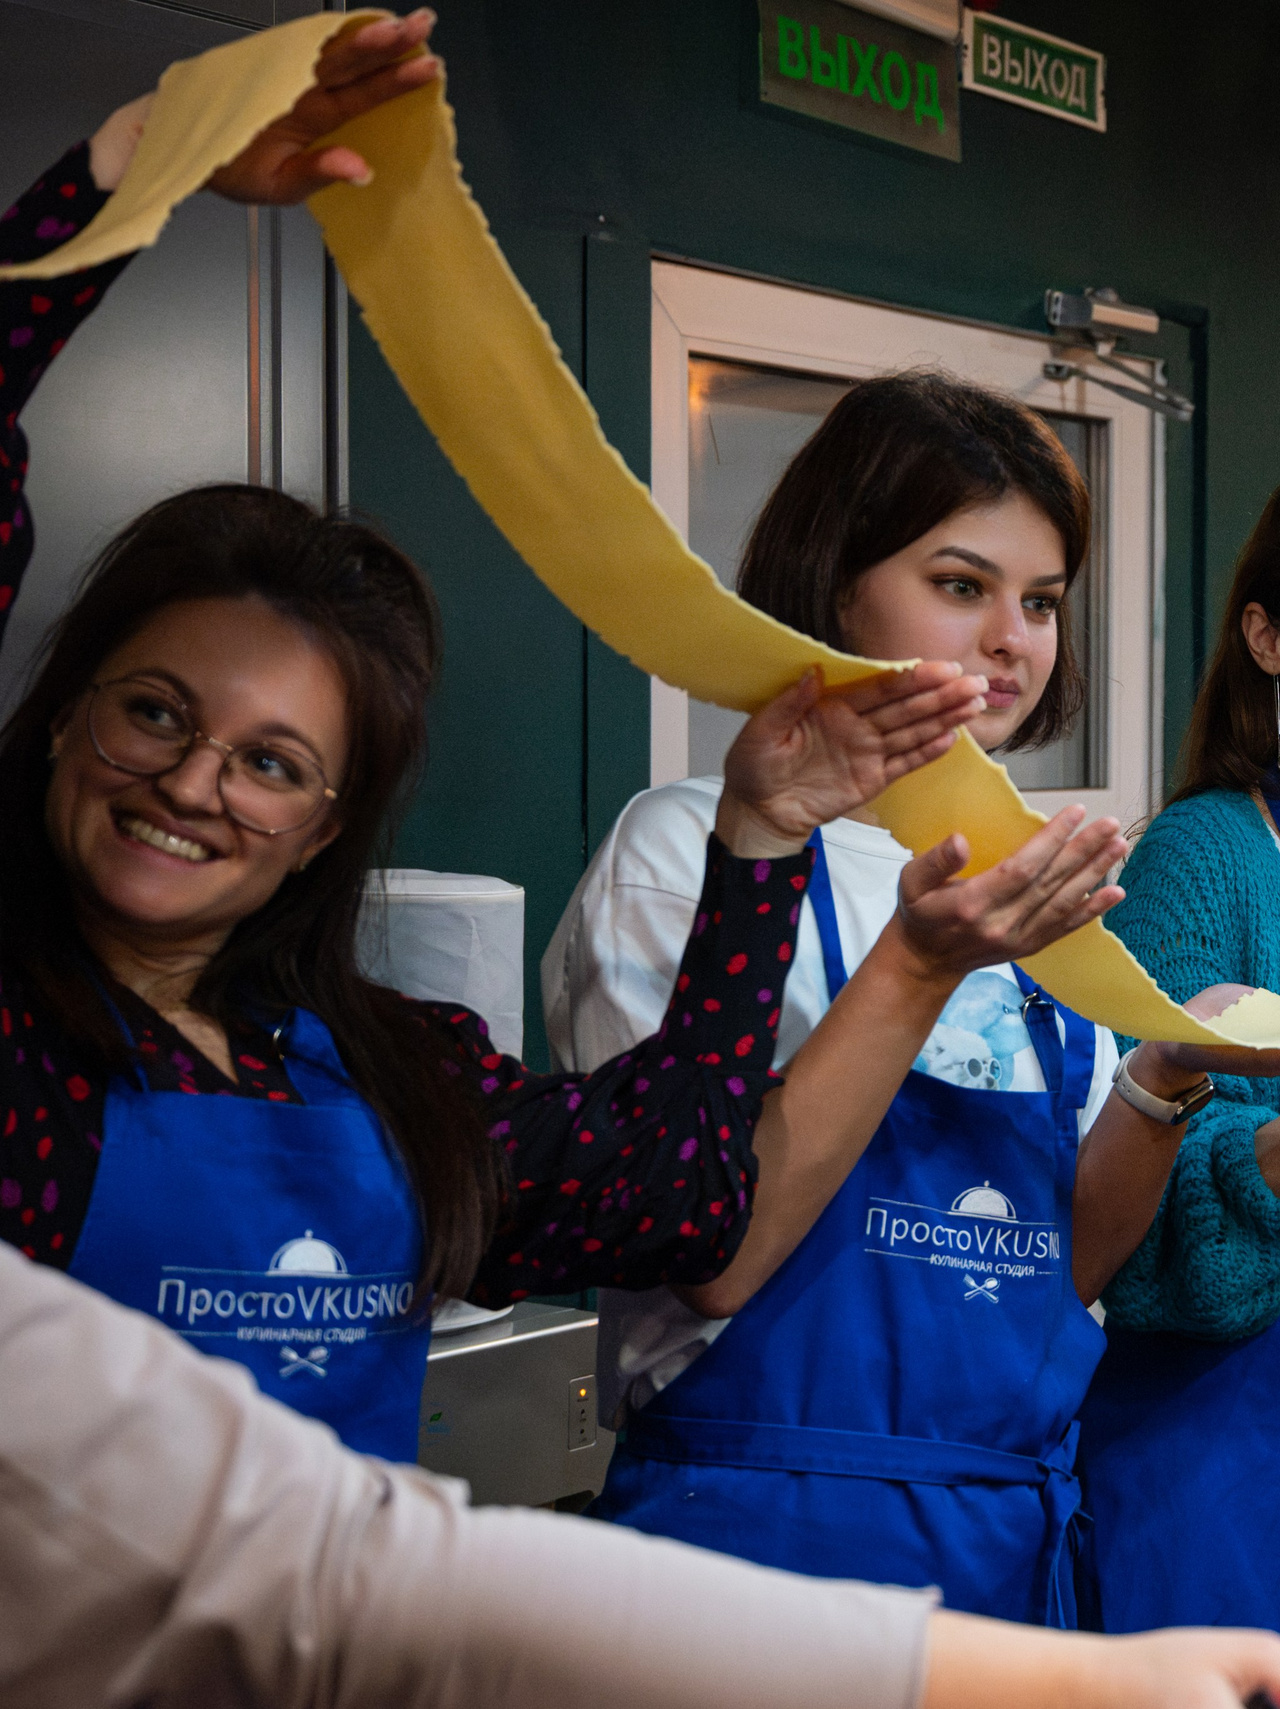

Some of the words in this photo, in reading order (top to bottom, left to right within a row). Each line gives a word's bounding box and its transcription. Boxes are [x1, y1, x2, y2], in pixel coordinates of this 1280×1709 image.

[777, 15, 945, 135] ВЫХОД
[982, 33, 1088, 112] ВЫХОД
[930, 1253, 993, 1274] КУЛИНАРНАЯ
[995, 1263, 1035, 1278] СТУДИЯ
[158, 1279, 414, 1325] ПростоVKUSNO
